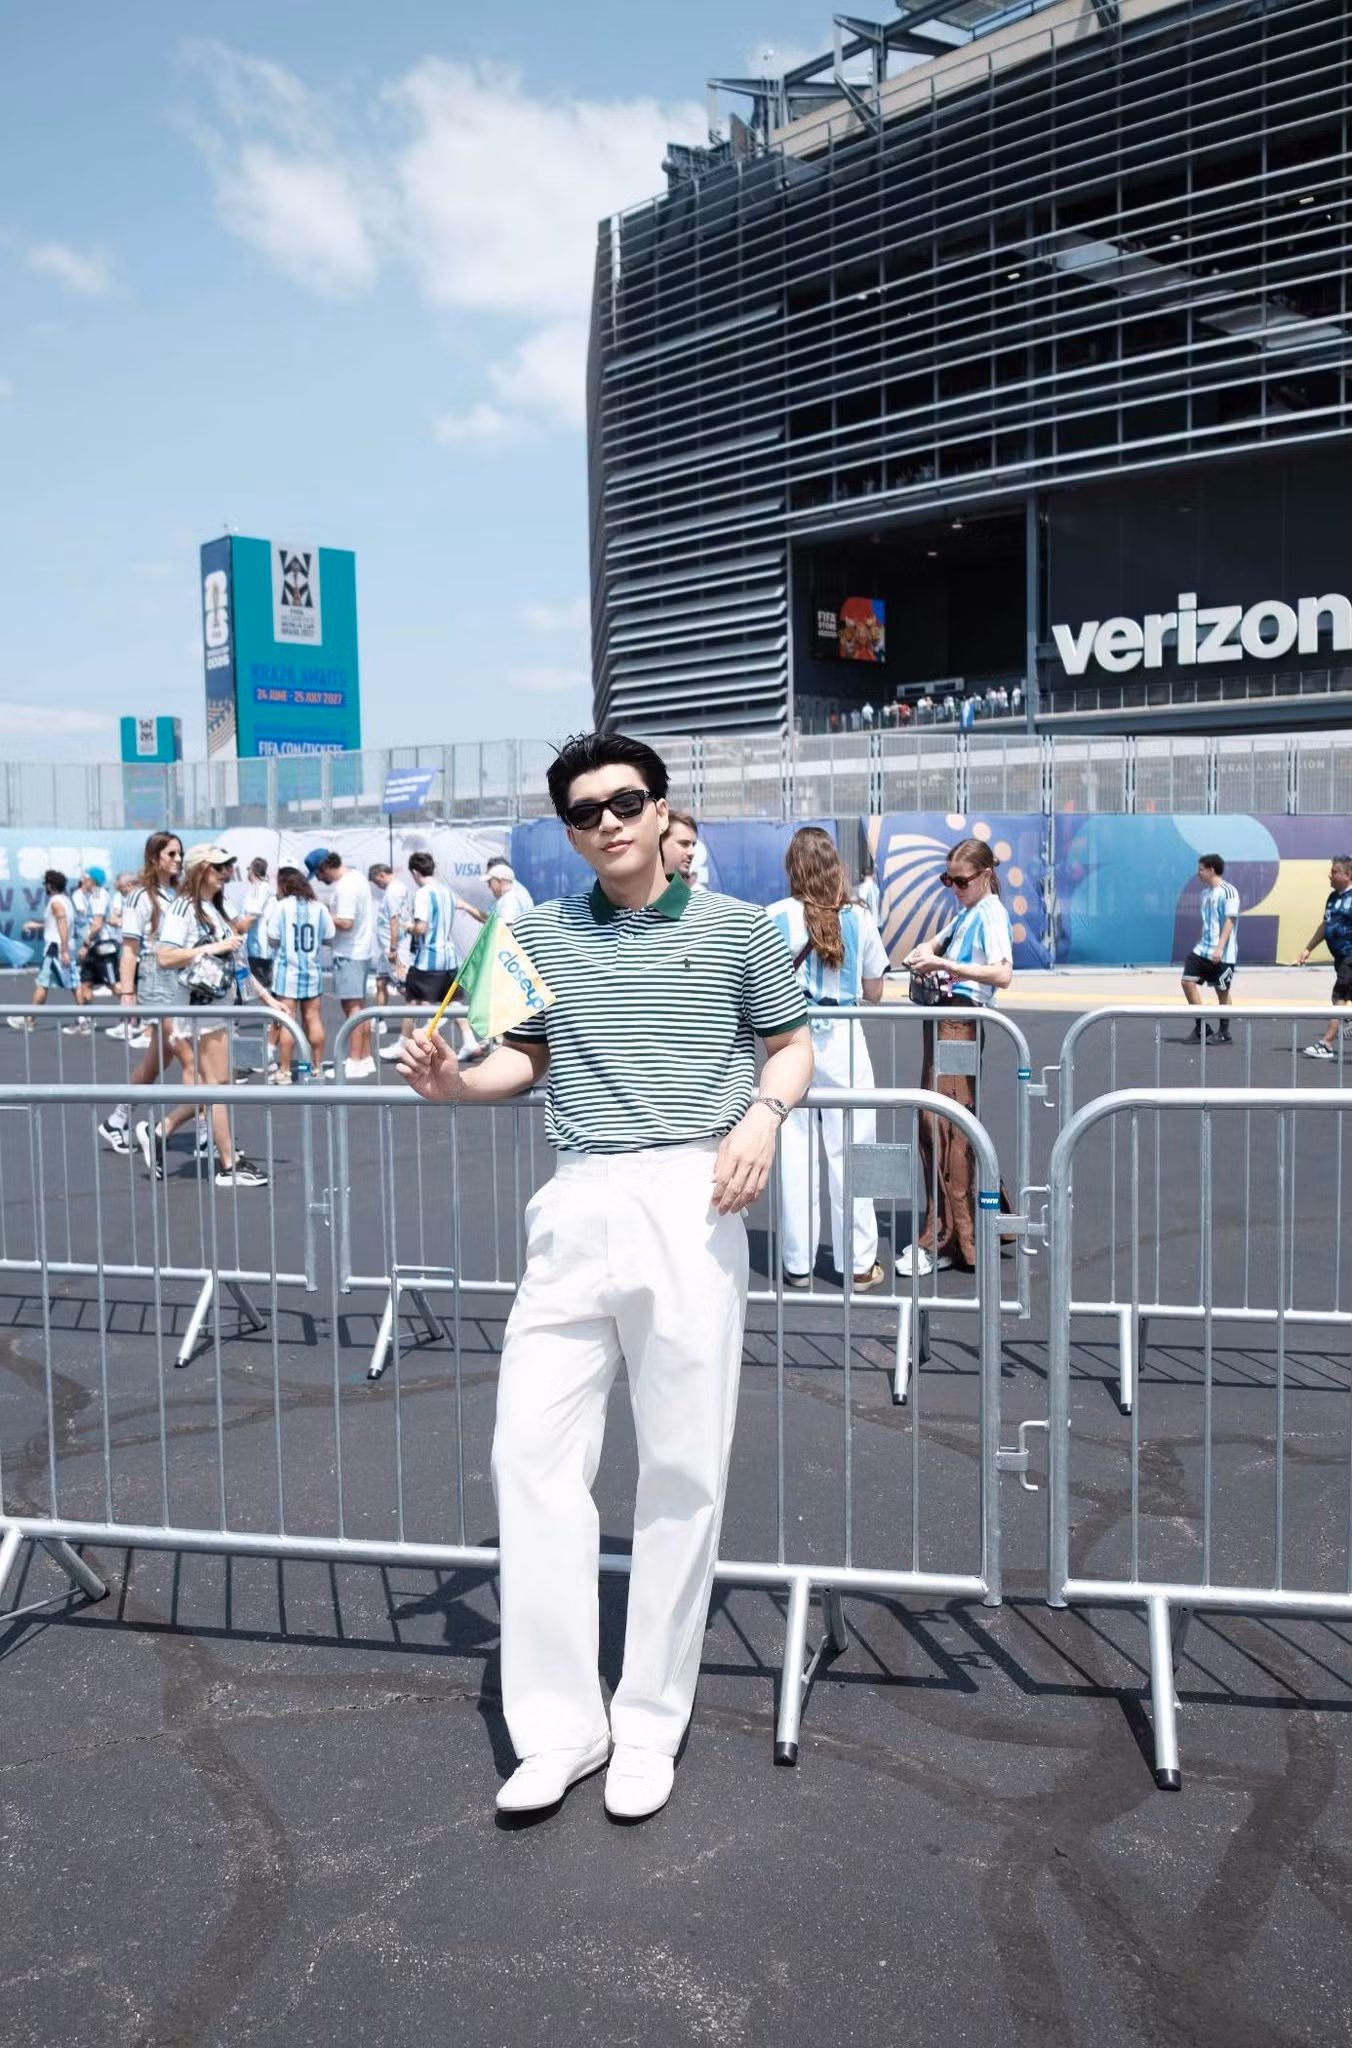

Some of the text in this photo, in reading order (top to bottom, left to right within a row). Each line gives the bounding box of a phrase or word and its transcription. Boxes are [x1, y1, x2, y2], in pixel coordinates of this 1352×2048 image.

[1051, 592, 1352, 676] verizon
[294, 690, 305, 703] 25
[454, 863, 482, 876] VISA
[292, 923, 315, 952] 10
[498, 950, 545, 1010] closeup
